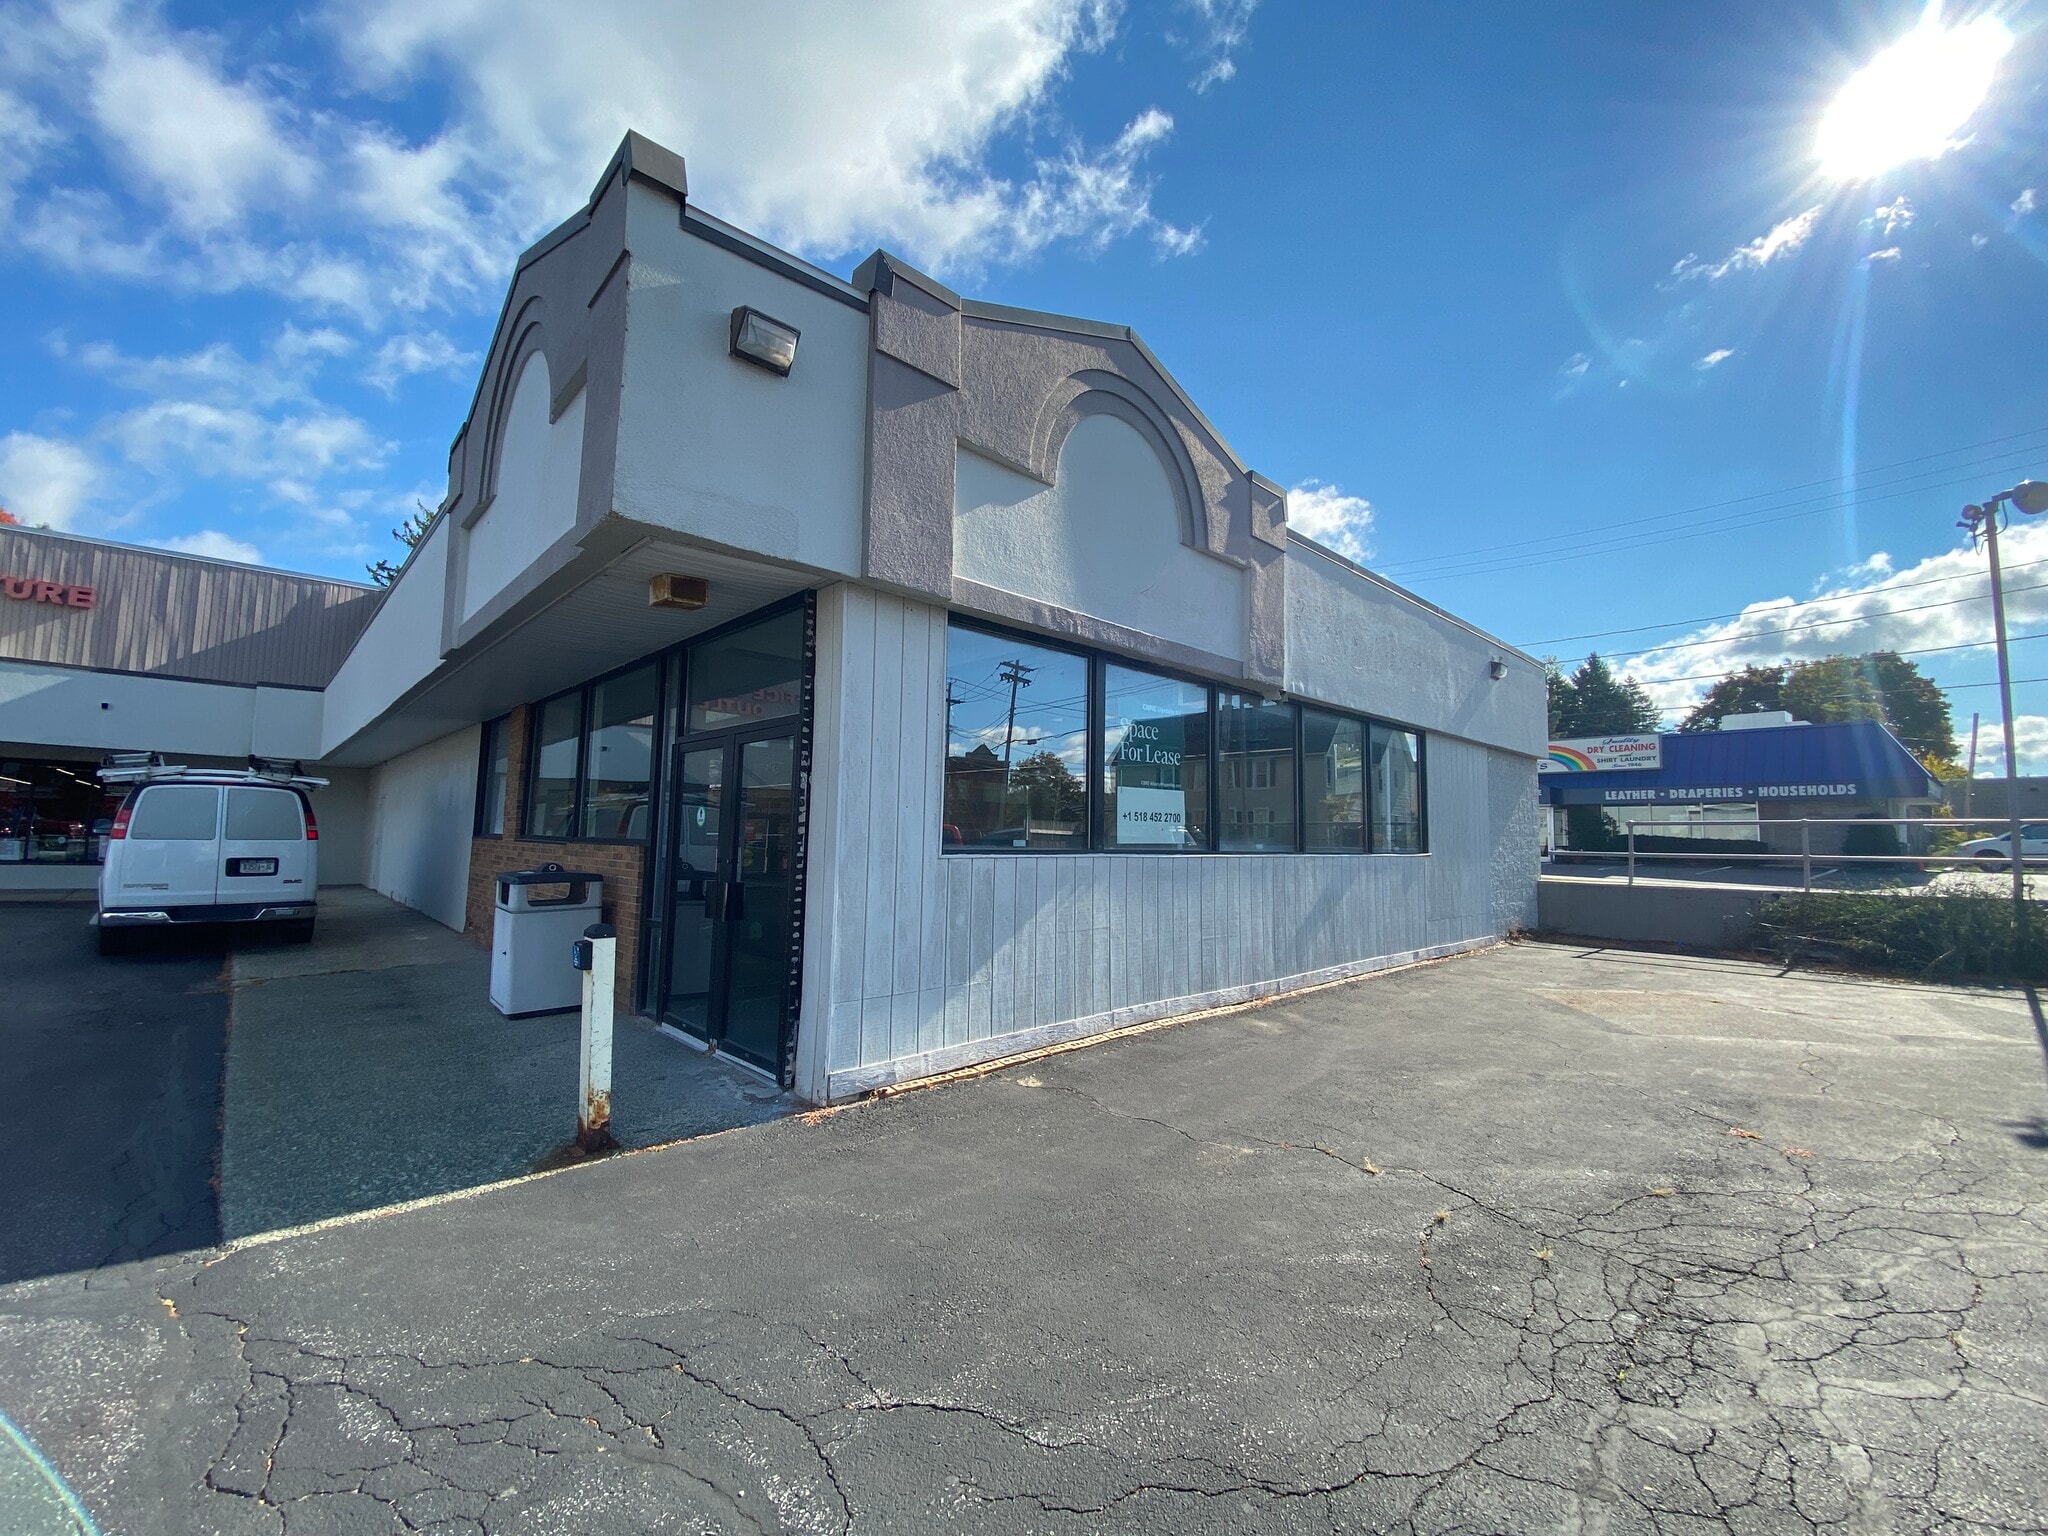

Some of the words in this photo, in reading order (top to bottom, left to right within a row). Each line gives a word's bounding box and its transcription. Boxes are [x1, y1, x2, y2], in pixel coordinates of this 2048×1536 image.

[0, 576, 96, 609] URE
[1120, 718, 1159, 742] Space
[1587, 746, 1605, 754] DRY
[1609, 743, 1656, 753] CLEANING
[1602, 737, 1639, 746] Quality
[1120, 741, 1143, 761] For
[1145, 744, 1180, 766] Lease
[1605, 790, 1656, 801] LEATHER
[1669, 788, 1743, 799] DRAPERIES
[1758, 784, 1857, 797] HOUSEHOLDS
[1122, 811, 1131, 821] +1
[1134, 811, 1148, 822] 518
[1149, 812, 1162, 822] 452
[1164, 812, 1181, 823] 2700
